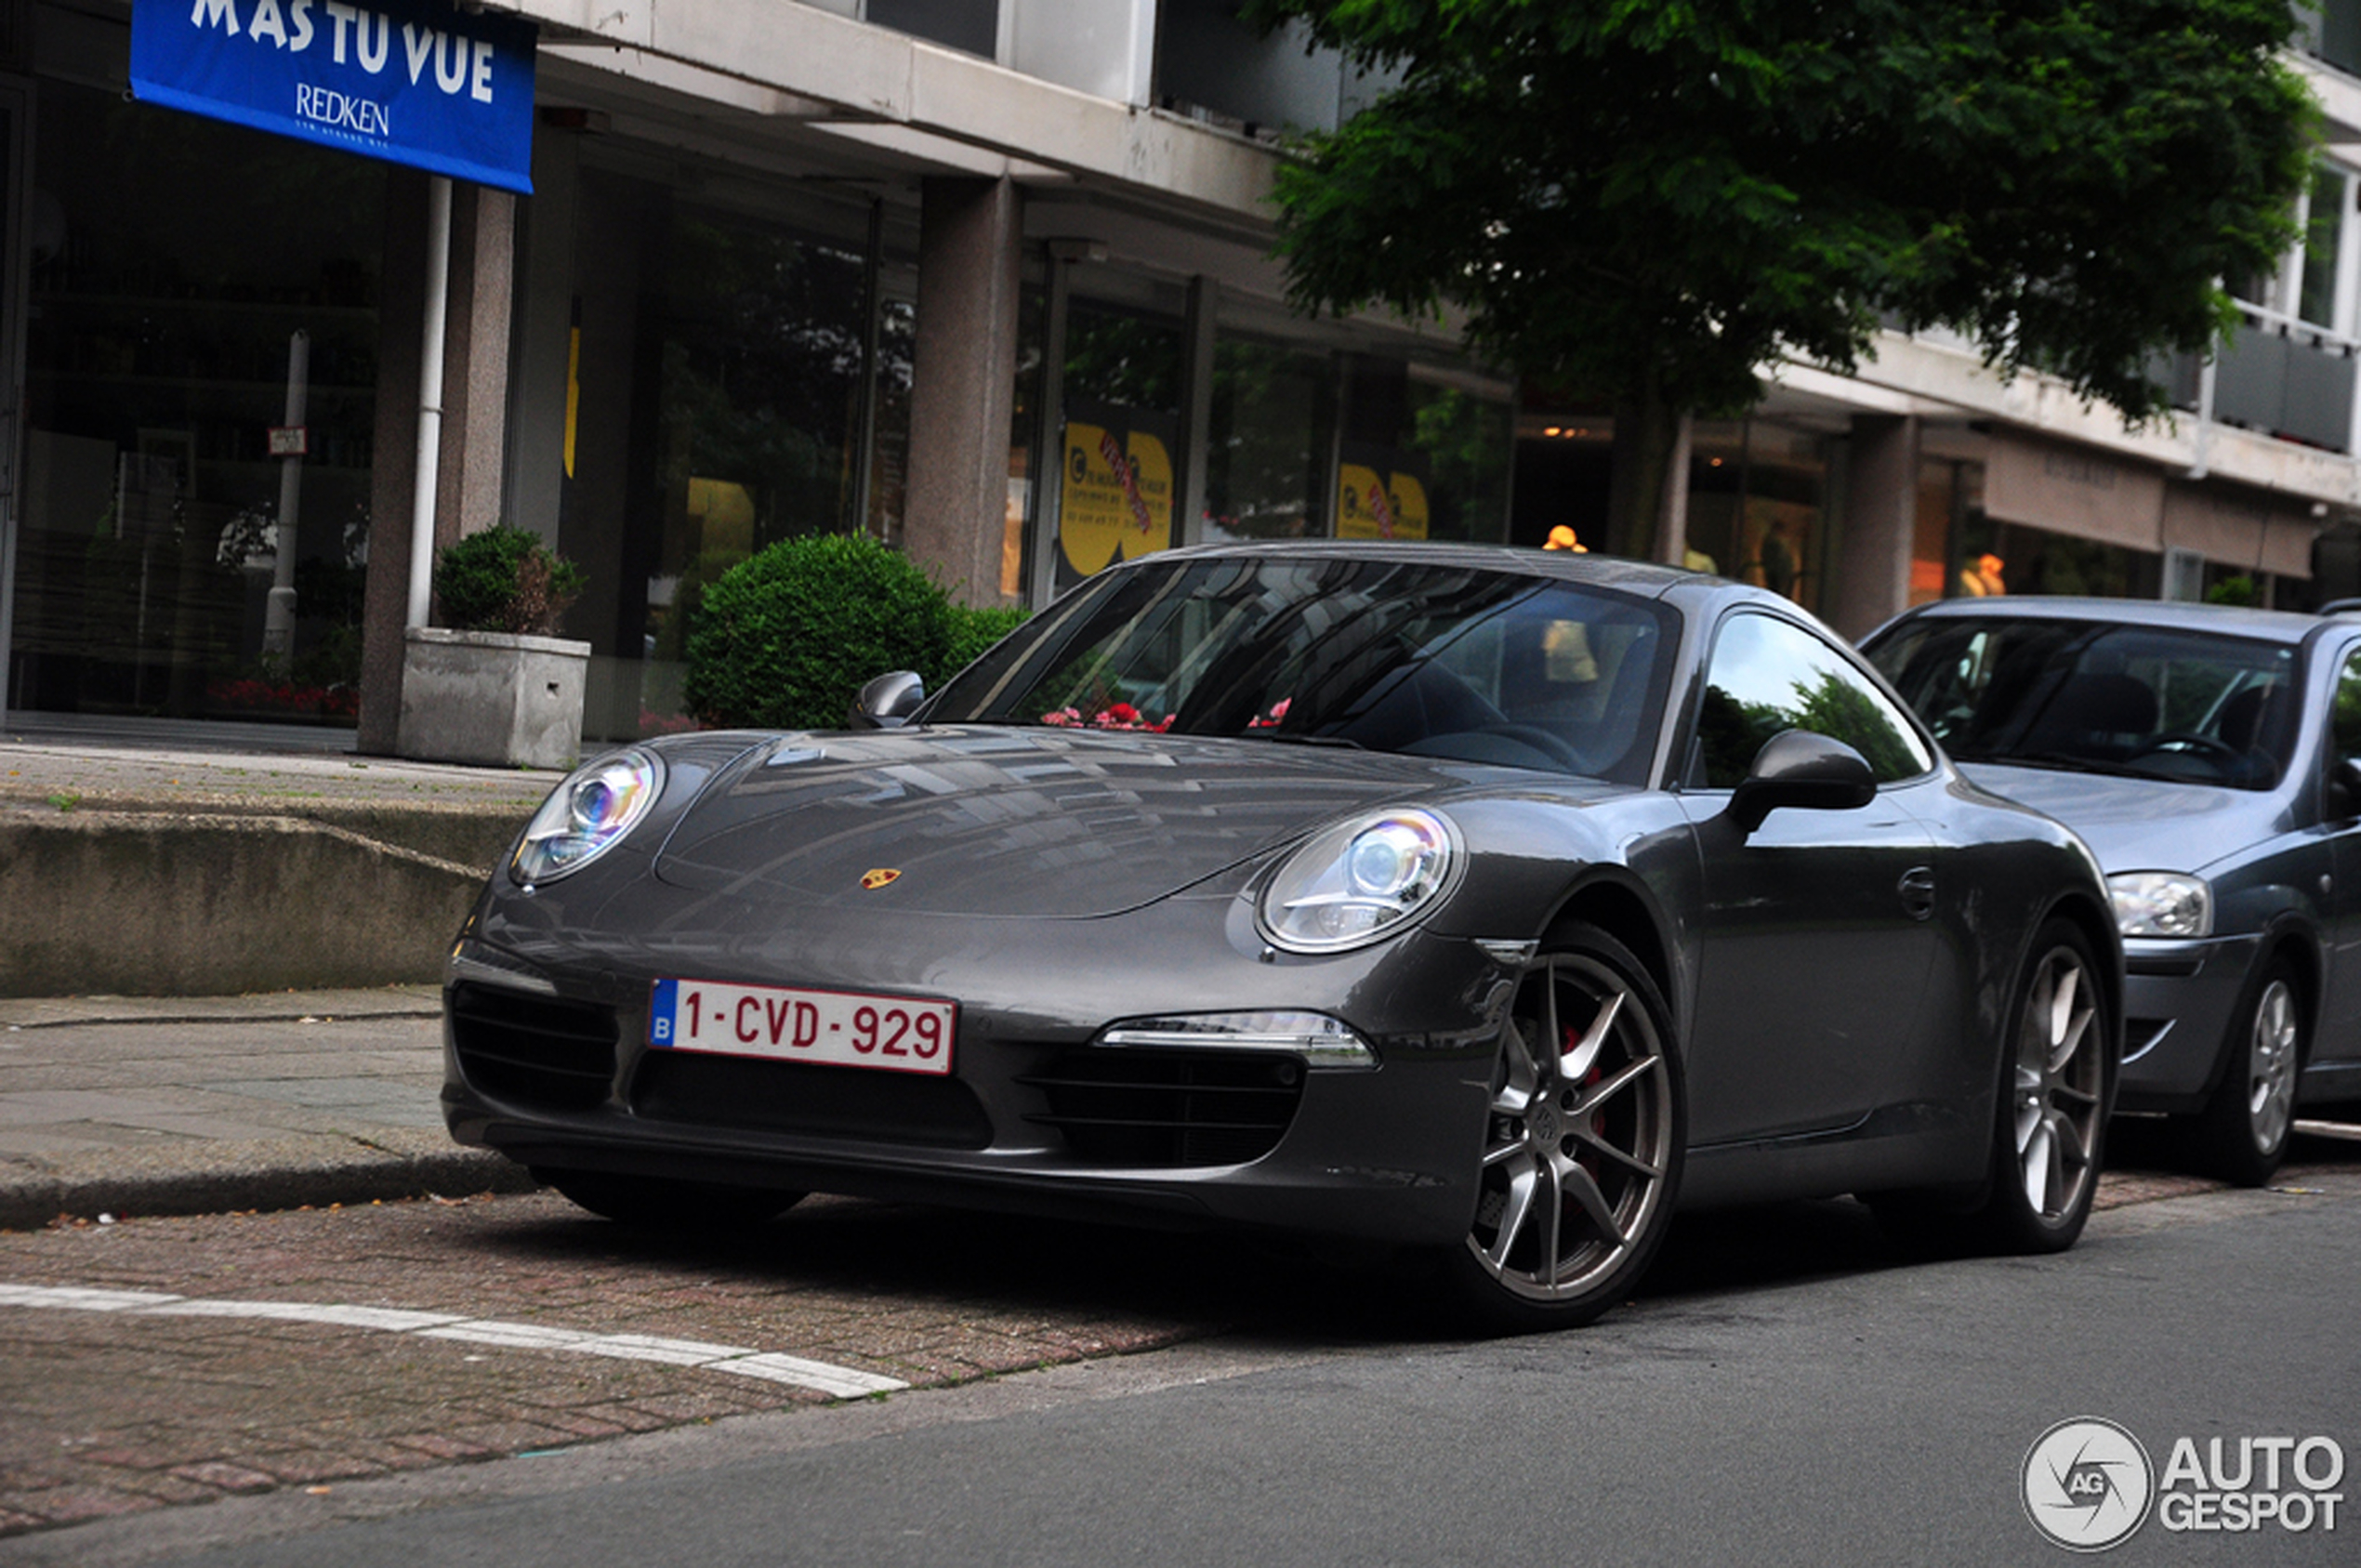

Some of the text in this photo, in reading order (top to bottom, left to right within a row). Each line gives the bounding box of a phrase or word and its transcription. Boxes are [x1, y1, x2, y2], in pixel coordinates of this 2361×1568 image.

[327, 0, 389, 74] TU
[402, 22, 493, 103] VUE
[297, 83, 389, 137] REDKEN
[654, 1017, 670, 1039] B
[686, 992, 942, 1059] 1-CVD-929
